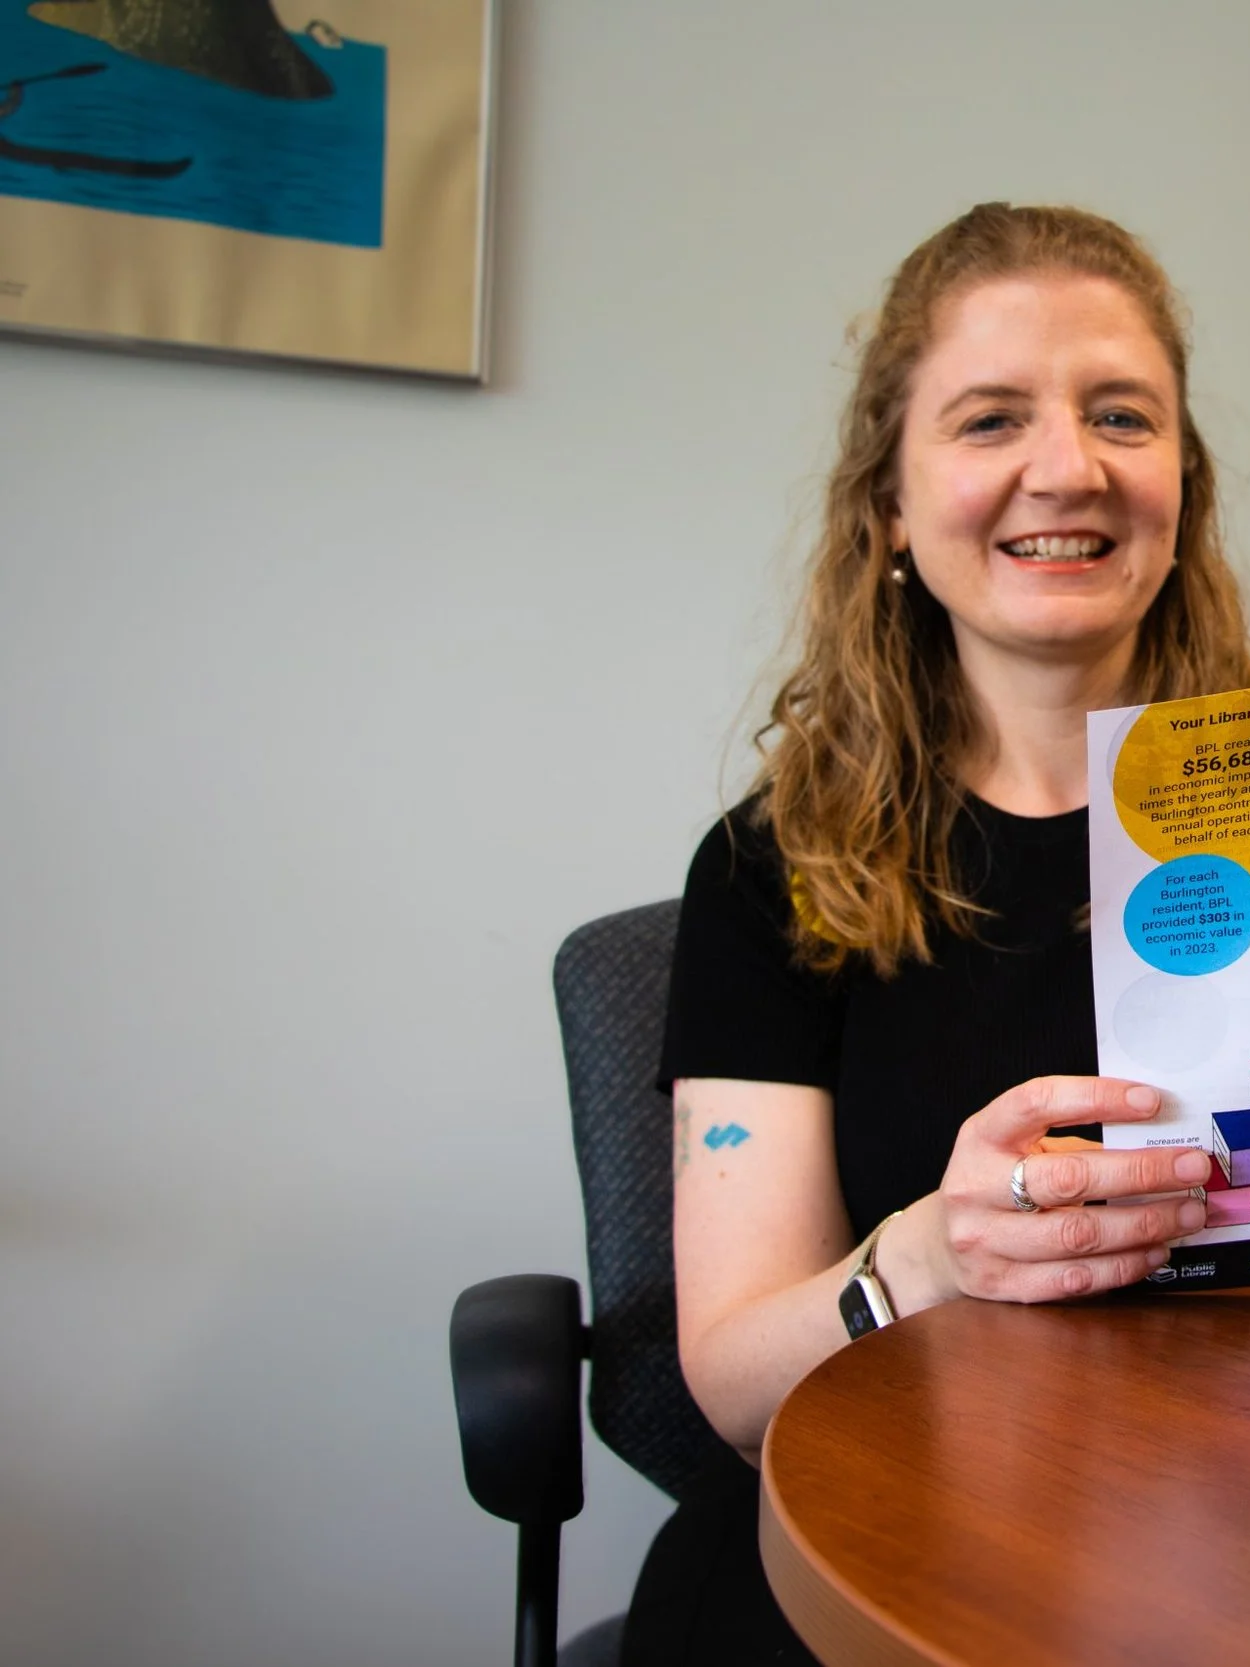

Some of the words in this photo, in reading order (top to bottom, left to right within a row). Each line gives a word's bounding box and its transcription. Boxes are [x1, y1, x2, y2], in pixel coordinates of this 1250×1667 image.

[1169, 717, 1205, 731] Your
[1195, 742, 1220, 755] BPL
[1148, 785, 1160, 796] in
[1163, 774, 1225, 793] economic
[1139, 798, 1174, 811] times
[1177, 793, 1198, 805] the
[1200, 786, 1238, 803] yearly
[1150, 804, 1215, 823] Burlington
[1161, 817, 1204, 834] annual
[1174, 829, 1213, 846] behalf
[1215, 827, 1229, 840] of
[1165, 875, 1186, 886] For
[1188, 869, 1219, 883] each
[1160, 884, 1225, 900] Burlington
[1208, 896, 1233, 909] BPL
[1141, 914, 1195, 933] provided
[1198, 911, 1231, 925] $303
[1233, 911, 1245, 921] in
[1145, 928, 1206, 944] economic
[1209, 926, 1243, 938] value
